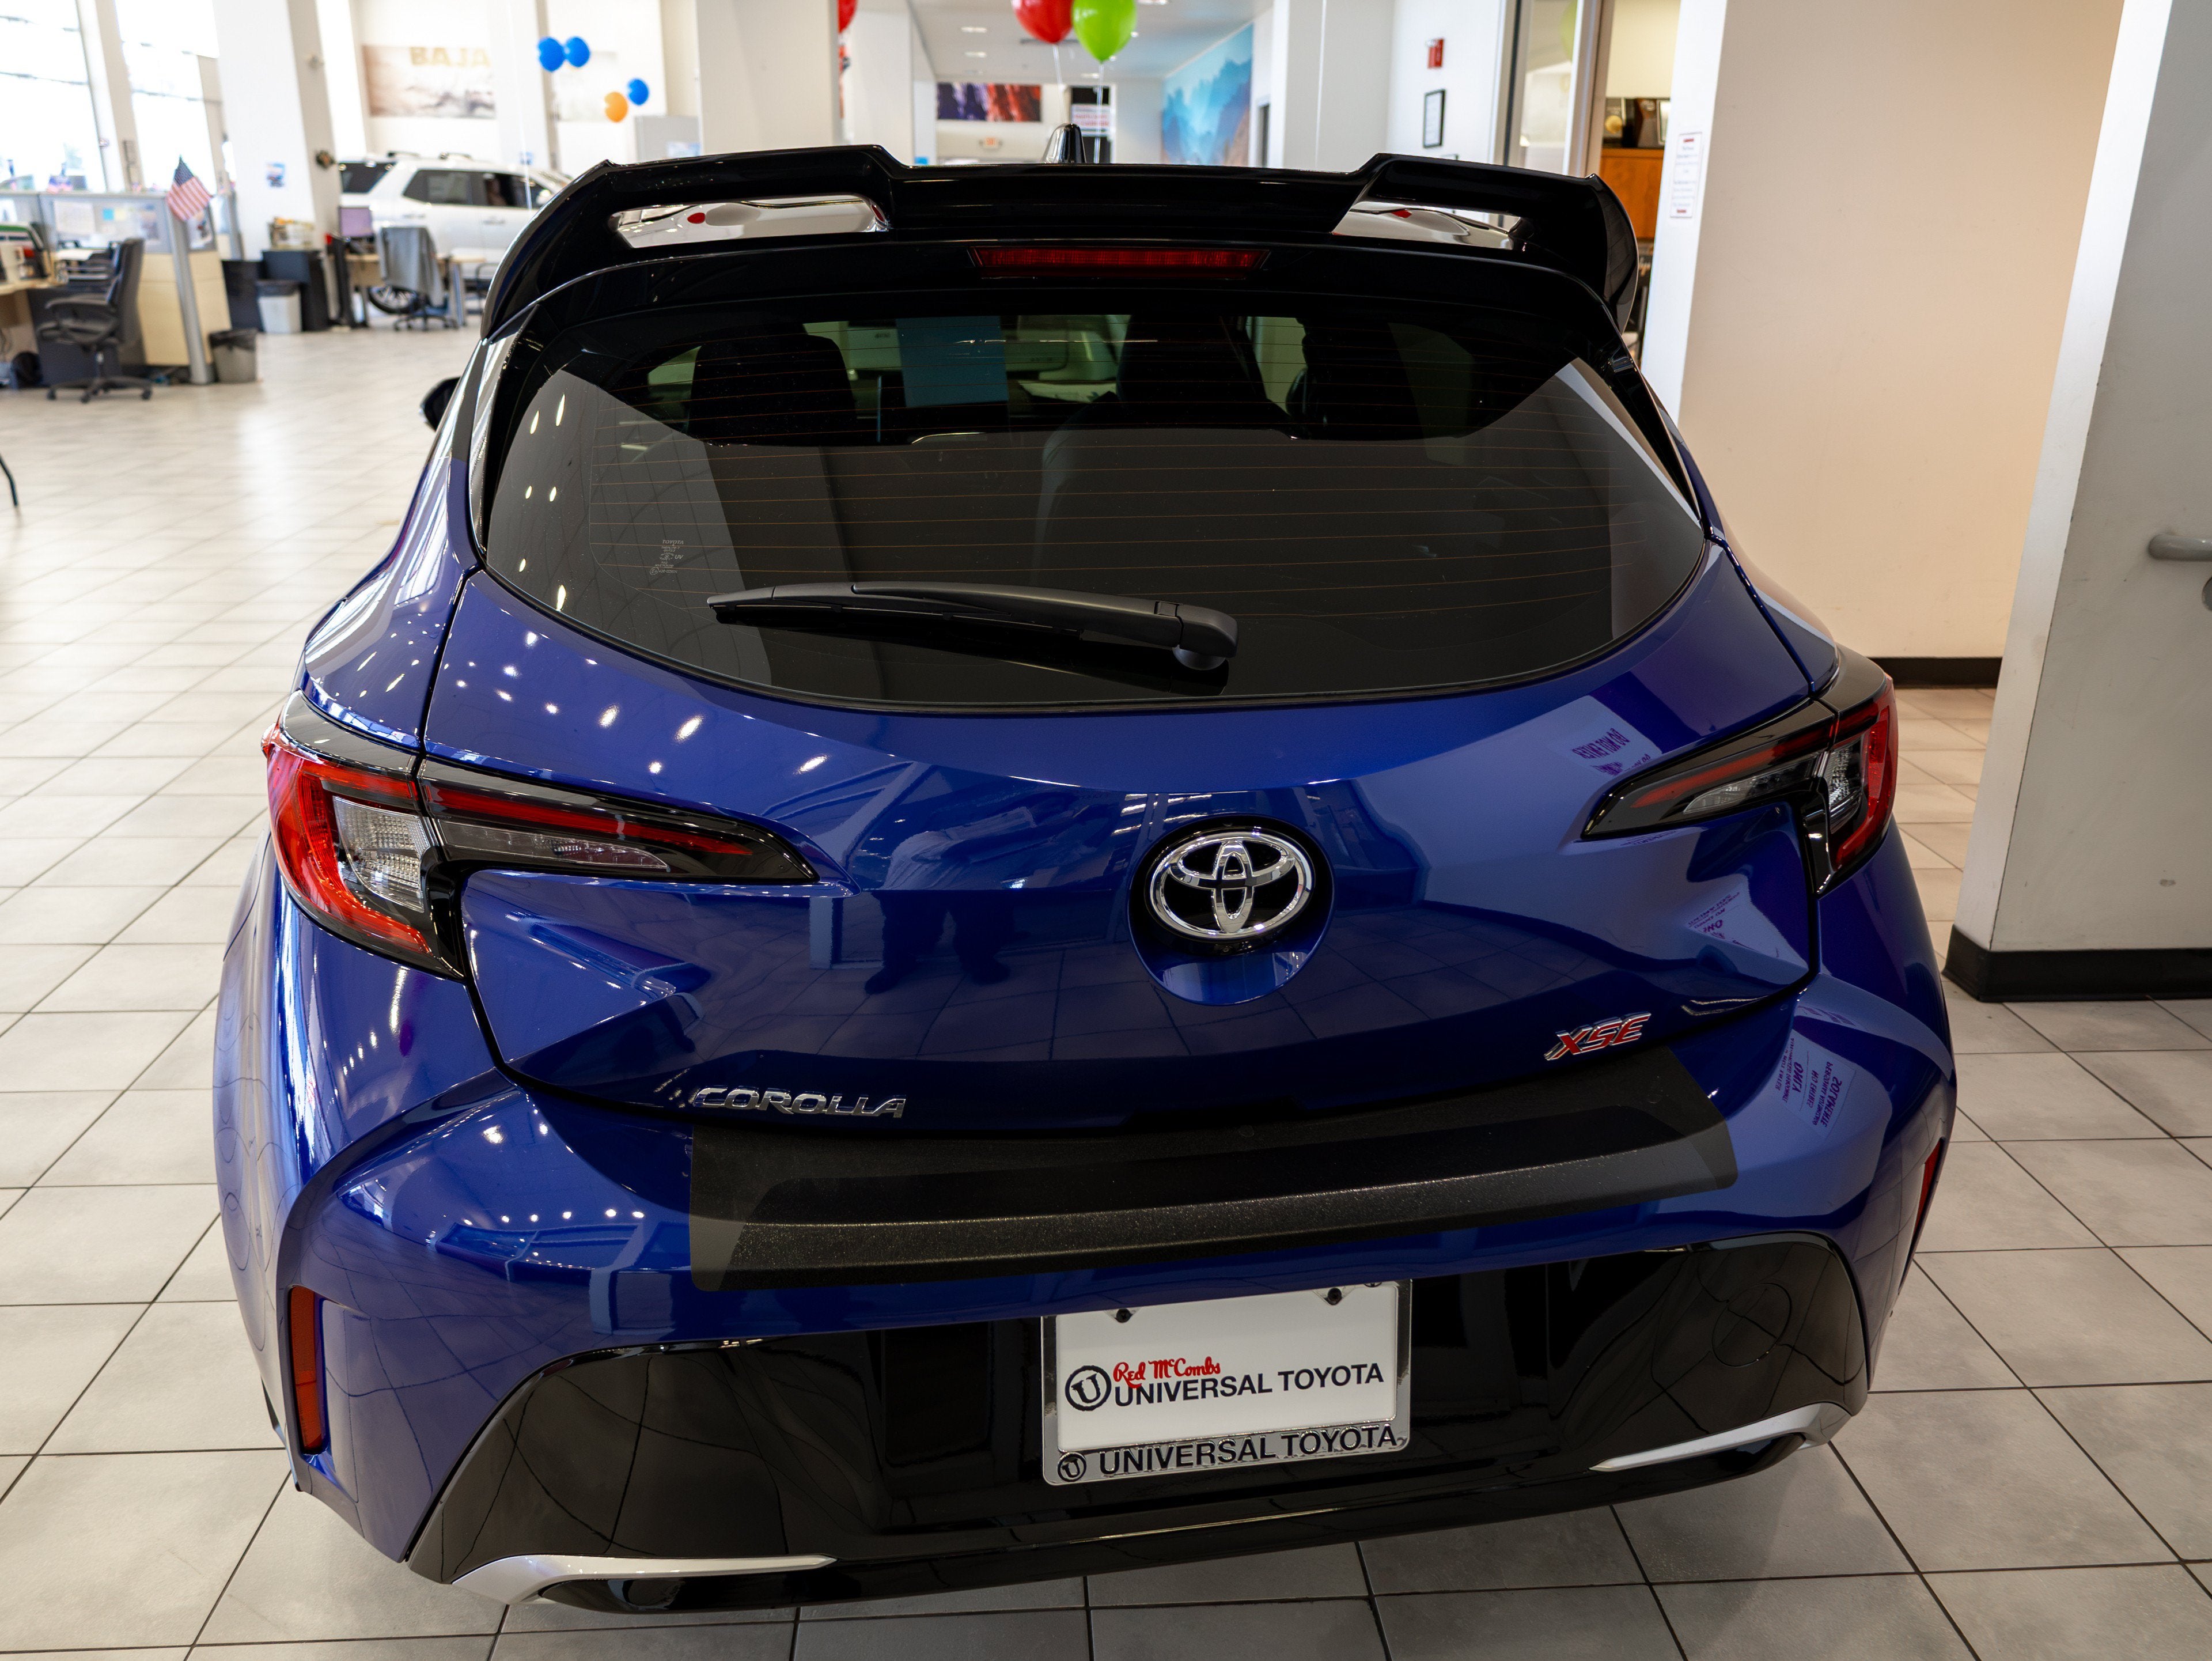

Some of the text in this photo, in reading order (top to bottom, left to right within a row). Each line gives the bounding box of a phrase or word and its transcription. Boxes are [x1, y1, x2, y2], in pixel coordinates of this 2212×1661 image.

[410, 46, 491, 68] BAJA
[1544, 1012, 1652, 1061] XSE
[692, 1085, 907, 1118] COROLLA
[1113, 1356, 1221, 1388] Red McCombs
[1115, 1363, 1384, 1407] UNIVERSAL TOYOTA
[1099, 1435, 1276, 1475] UNIVERSAL
[1281, 1423, 1397, 1456] TOYOTA
